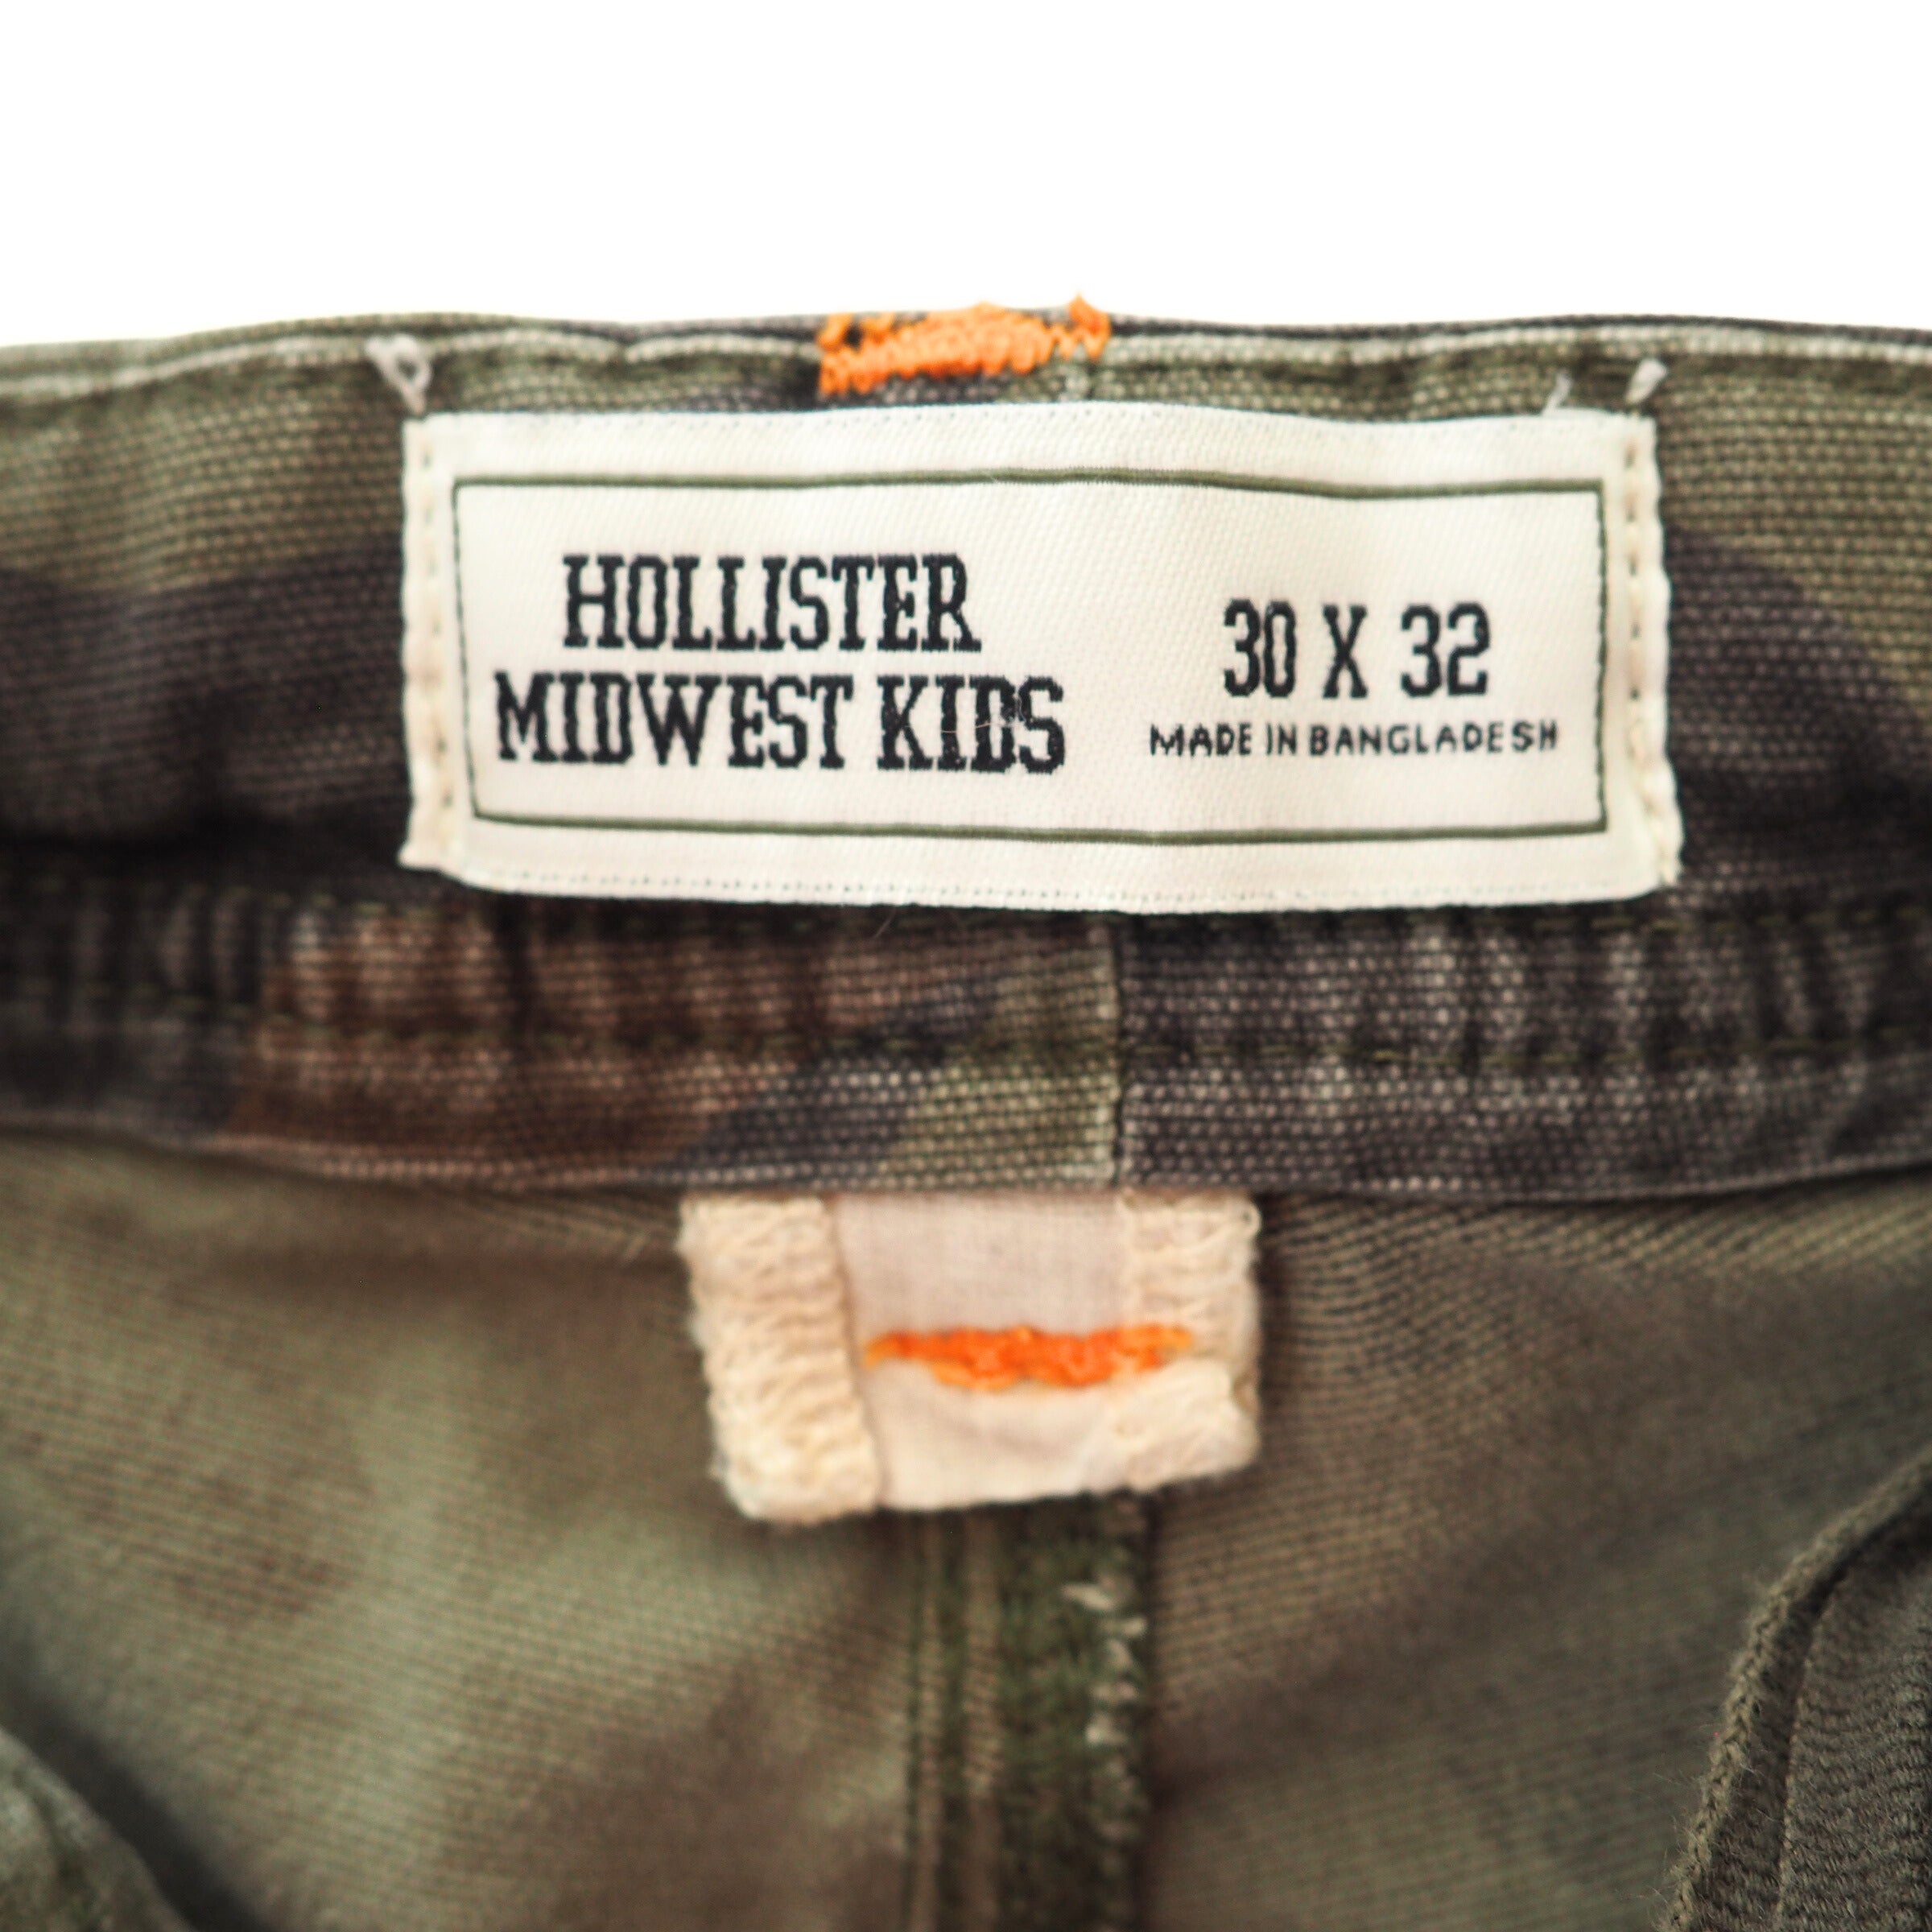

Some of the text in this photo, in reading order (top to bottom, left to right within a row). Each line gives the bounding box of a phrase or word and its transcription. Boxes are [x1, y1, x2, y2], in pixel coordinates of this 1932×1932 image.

[563, 553, 982, 653] HOLLISTER
[1223, 598, 1491, 699] 30 X 32
[493, 671, 1066, 775] MIDWEST KIDS
[1150, 720, 1558, 757] MADE IN BANGLADESH
